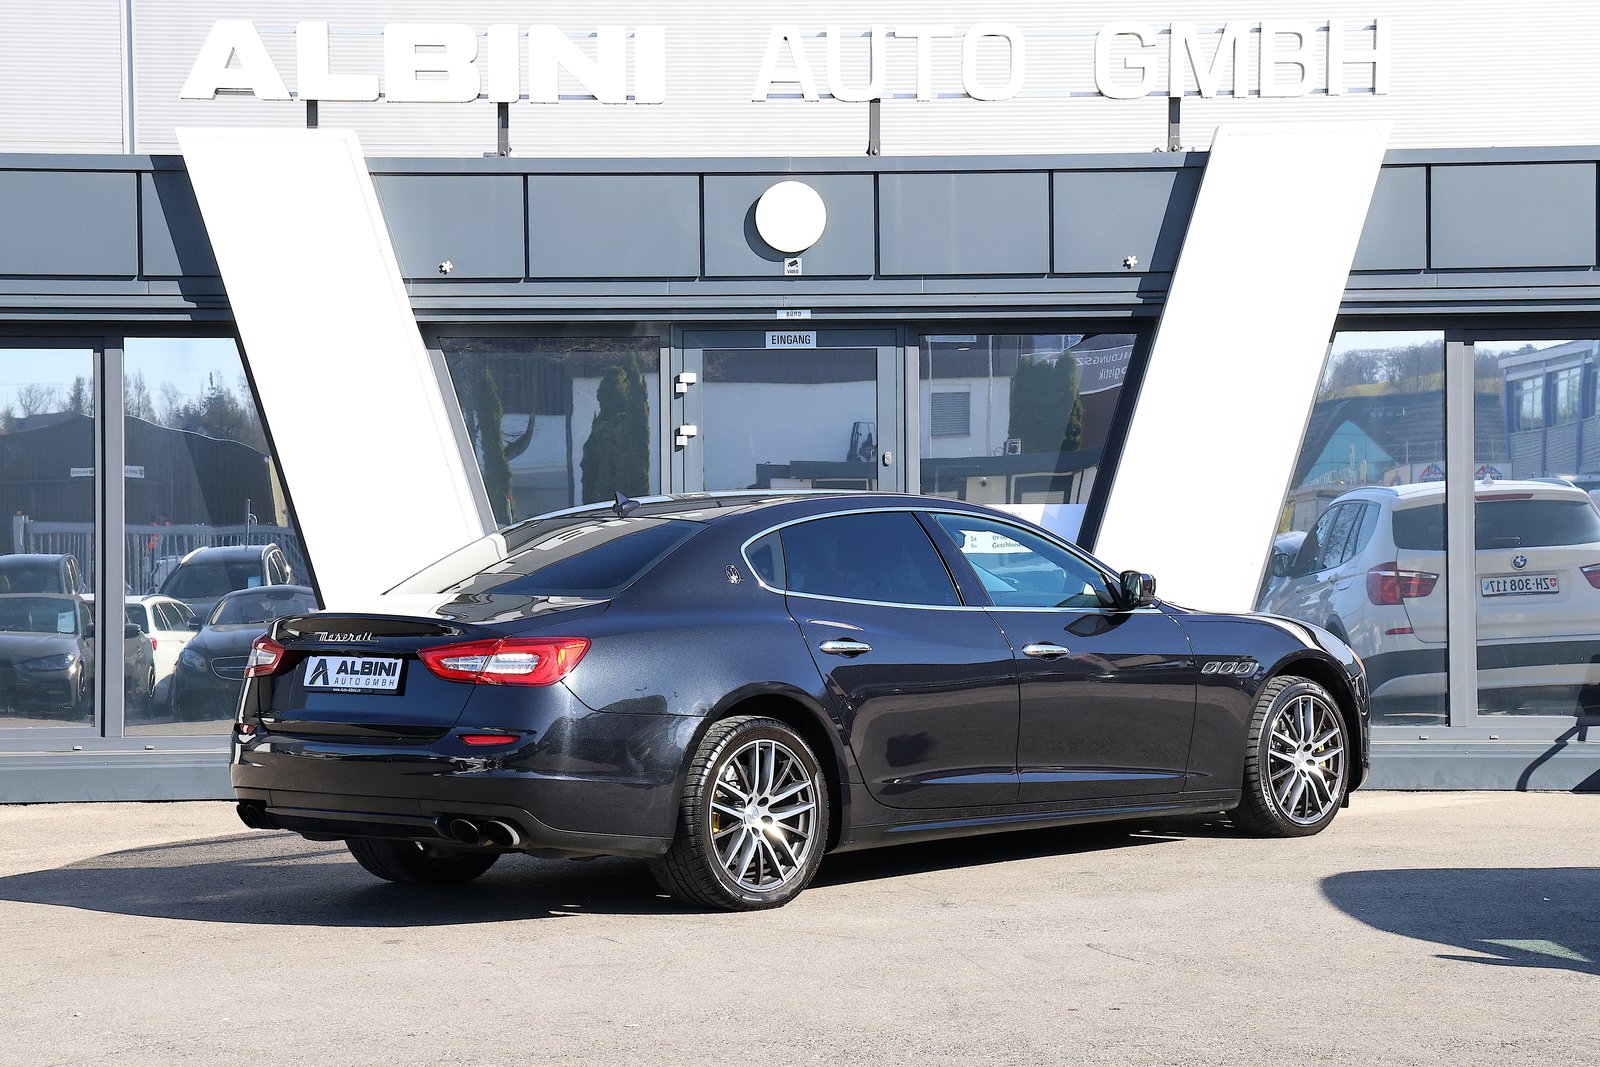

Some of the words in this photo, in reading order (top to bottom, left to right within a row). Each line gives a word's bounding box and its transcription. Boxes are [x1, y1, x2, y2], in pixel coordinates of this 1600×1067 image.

[178, 19, 667, 105] ALBINI
[751, 20, 1026, 103] AUTO
[1093, 18, 1392, 100] GMBH
[771, 334, 811, 345] EINGANG
[315, 631, 378, 642] Maserati
[336, 660, 398, 677] ALBINI
[334, 677, 360, 686] AUTO
[365, 678, 395, 687] GMBH
